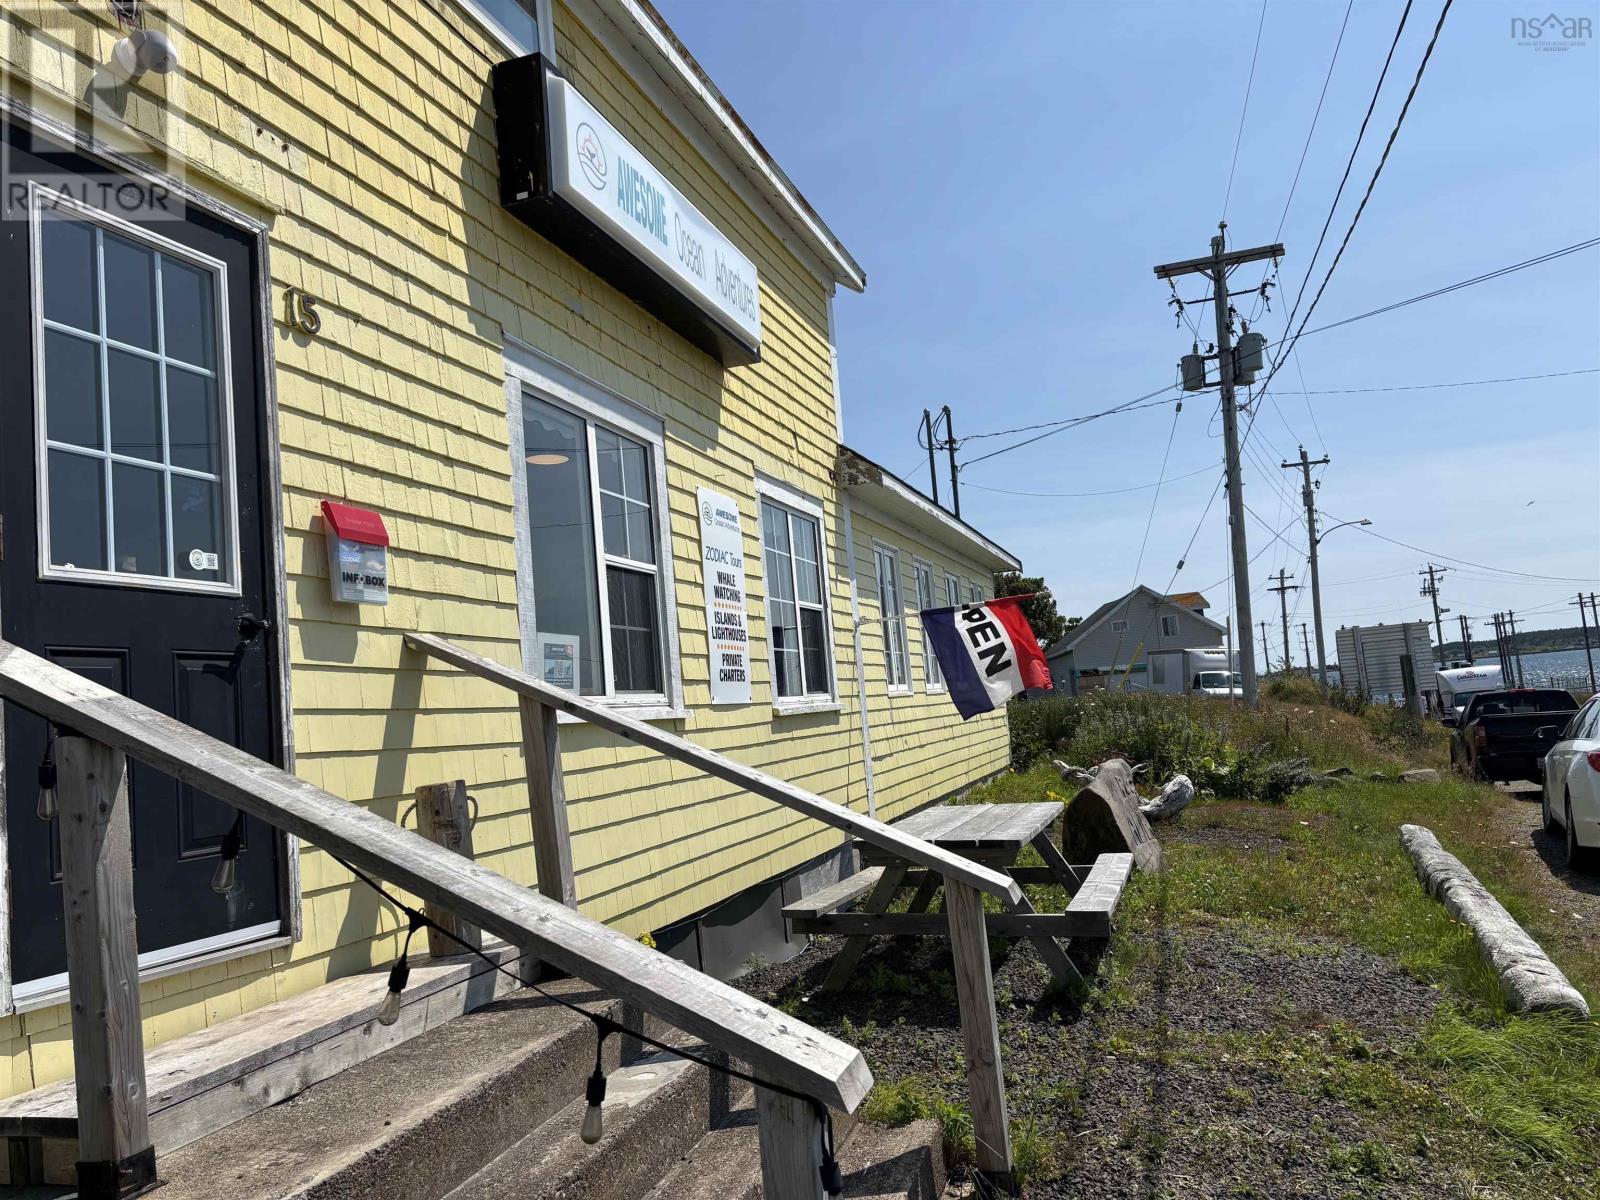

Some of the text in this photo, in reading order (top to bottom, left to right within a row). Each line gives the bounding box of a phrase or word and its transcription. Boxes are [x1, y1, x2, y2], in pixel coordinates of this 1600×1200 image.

[617, 156, 756, 323] AWESOME Ocean Adventures
[282, 286, 321, 334] 15
[715, 508, 738, 524] AWESOME
[705, 545, 742, 569] ZODIAC Tours
[717, 570, 736, 588] WHALE
[713, 585, 741, 603] WATCHING
[714, 611, 742, 627] ISLANDS &
[711, 626, 747, 643] LIGHTHOUSES
[721, 653, 743, 668] PRIVATE
[719, 669, 746, 682] CHARTERS
